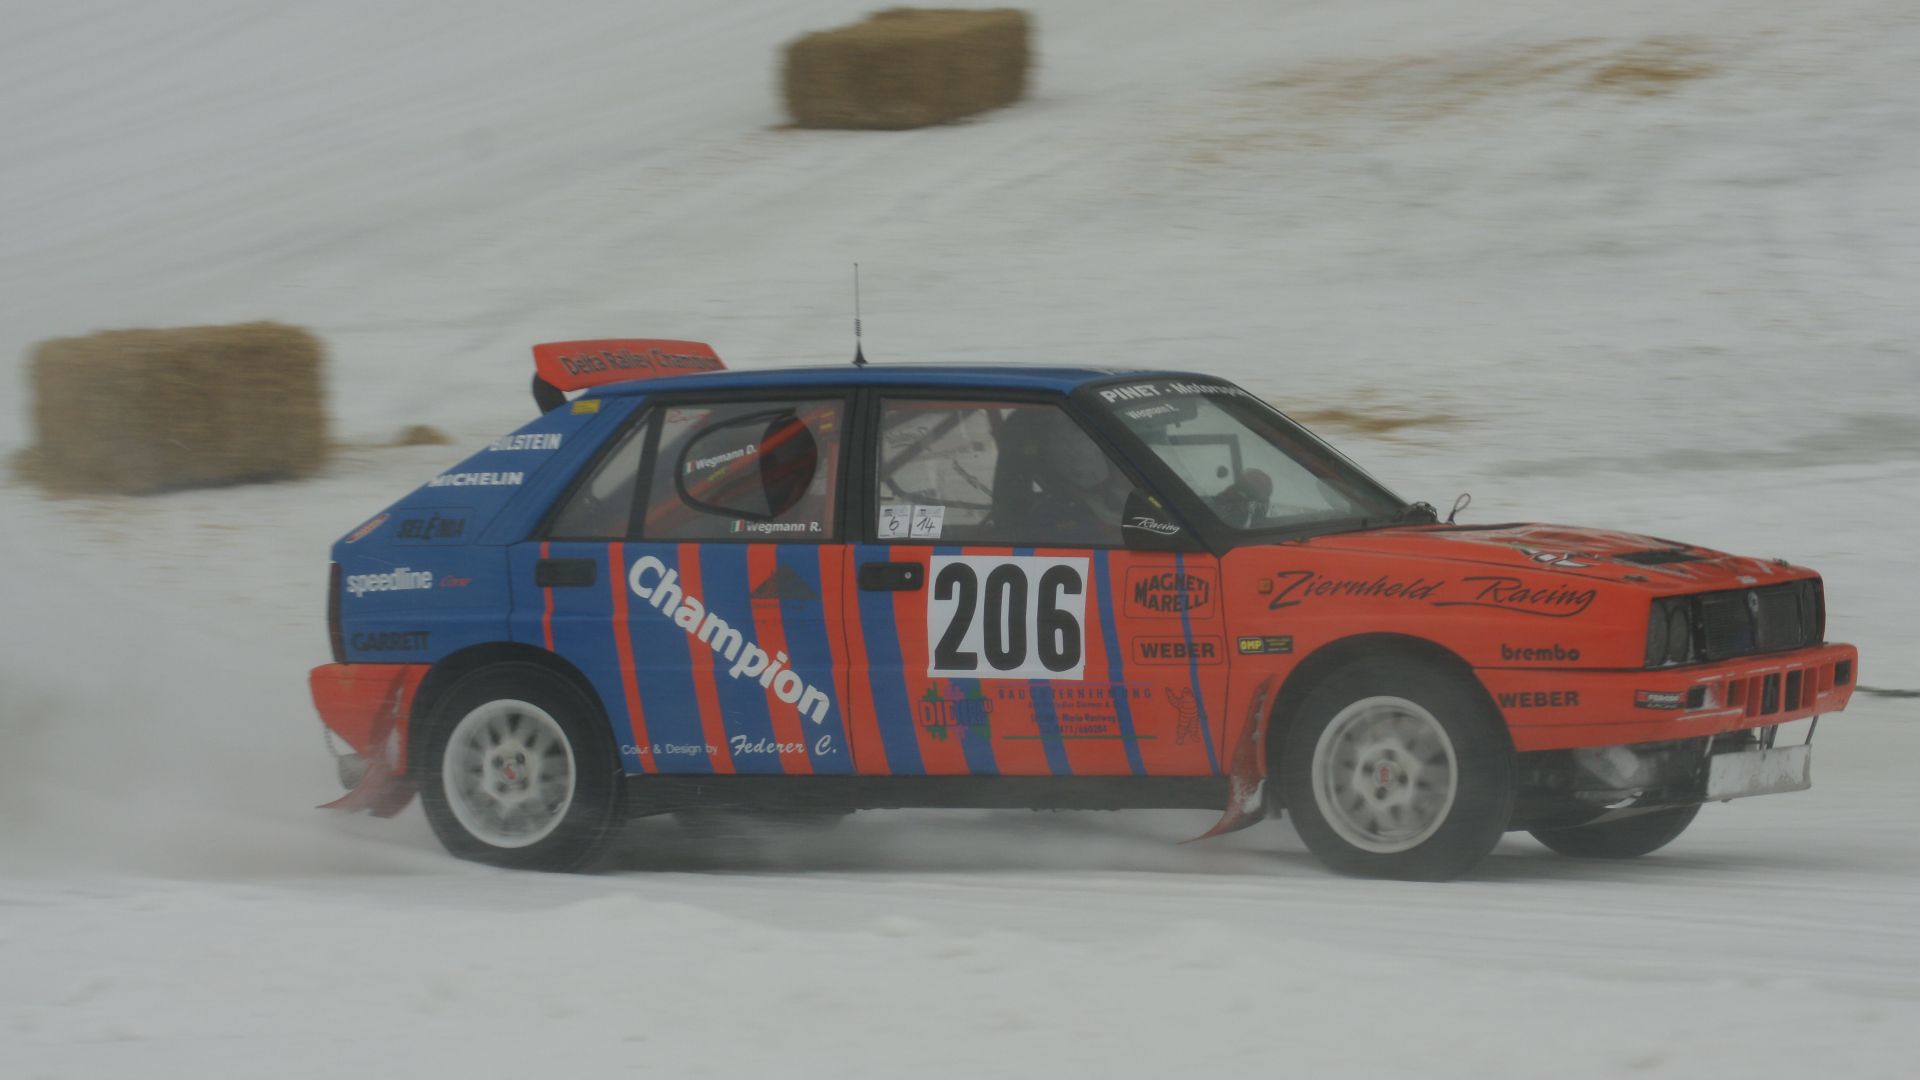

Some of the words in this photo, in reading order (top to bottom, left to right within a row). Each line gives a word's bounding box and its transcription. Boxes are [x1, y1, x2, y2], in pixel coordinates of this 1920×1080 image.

[1099, 384, 1161, 403] PINET
[695, 449, 745, 470] Wegmann
[428, 472, 524, 488] MICHELIN
[746, 522, 806, 534] Wegmann
[809, 521, 822, 533] R.
[916, 516, 935, 534] 14
[346, 567, 433, 598] speedline
[1135, 573, 1209, 598] MAGNETI
[1135, 588, 1209, 612] MARELLI
[1430, 576, 1598, 618] Racing
[934, 562, 1083, 672] 206
[628, 555, 830, 725] Champion
[1140, 642, 1215, 659] WEBER
[1501, 644, 1580, 662] brembo
[1498, 690, 1580, 709] WEBER
[665, 743, 702, 757] Design
[705, 744, 718, 756] by
[730, 735, 806, 756] Federer
[815, 734, 837, 756] C.
